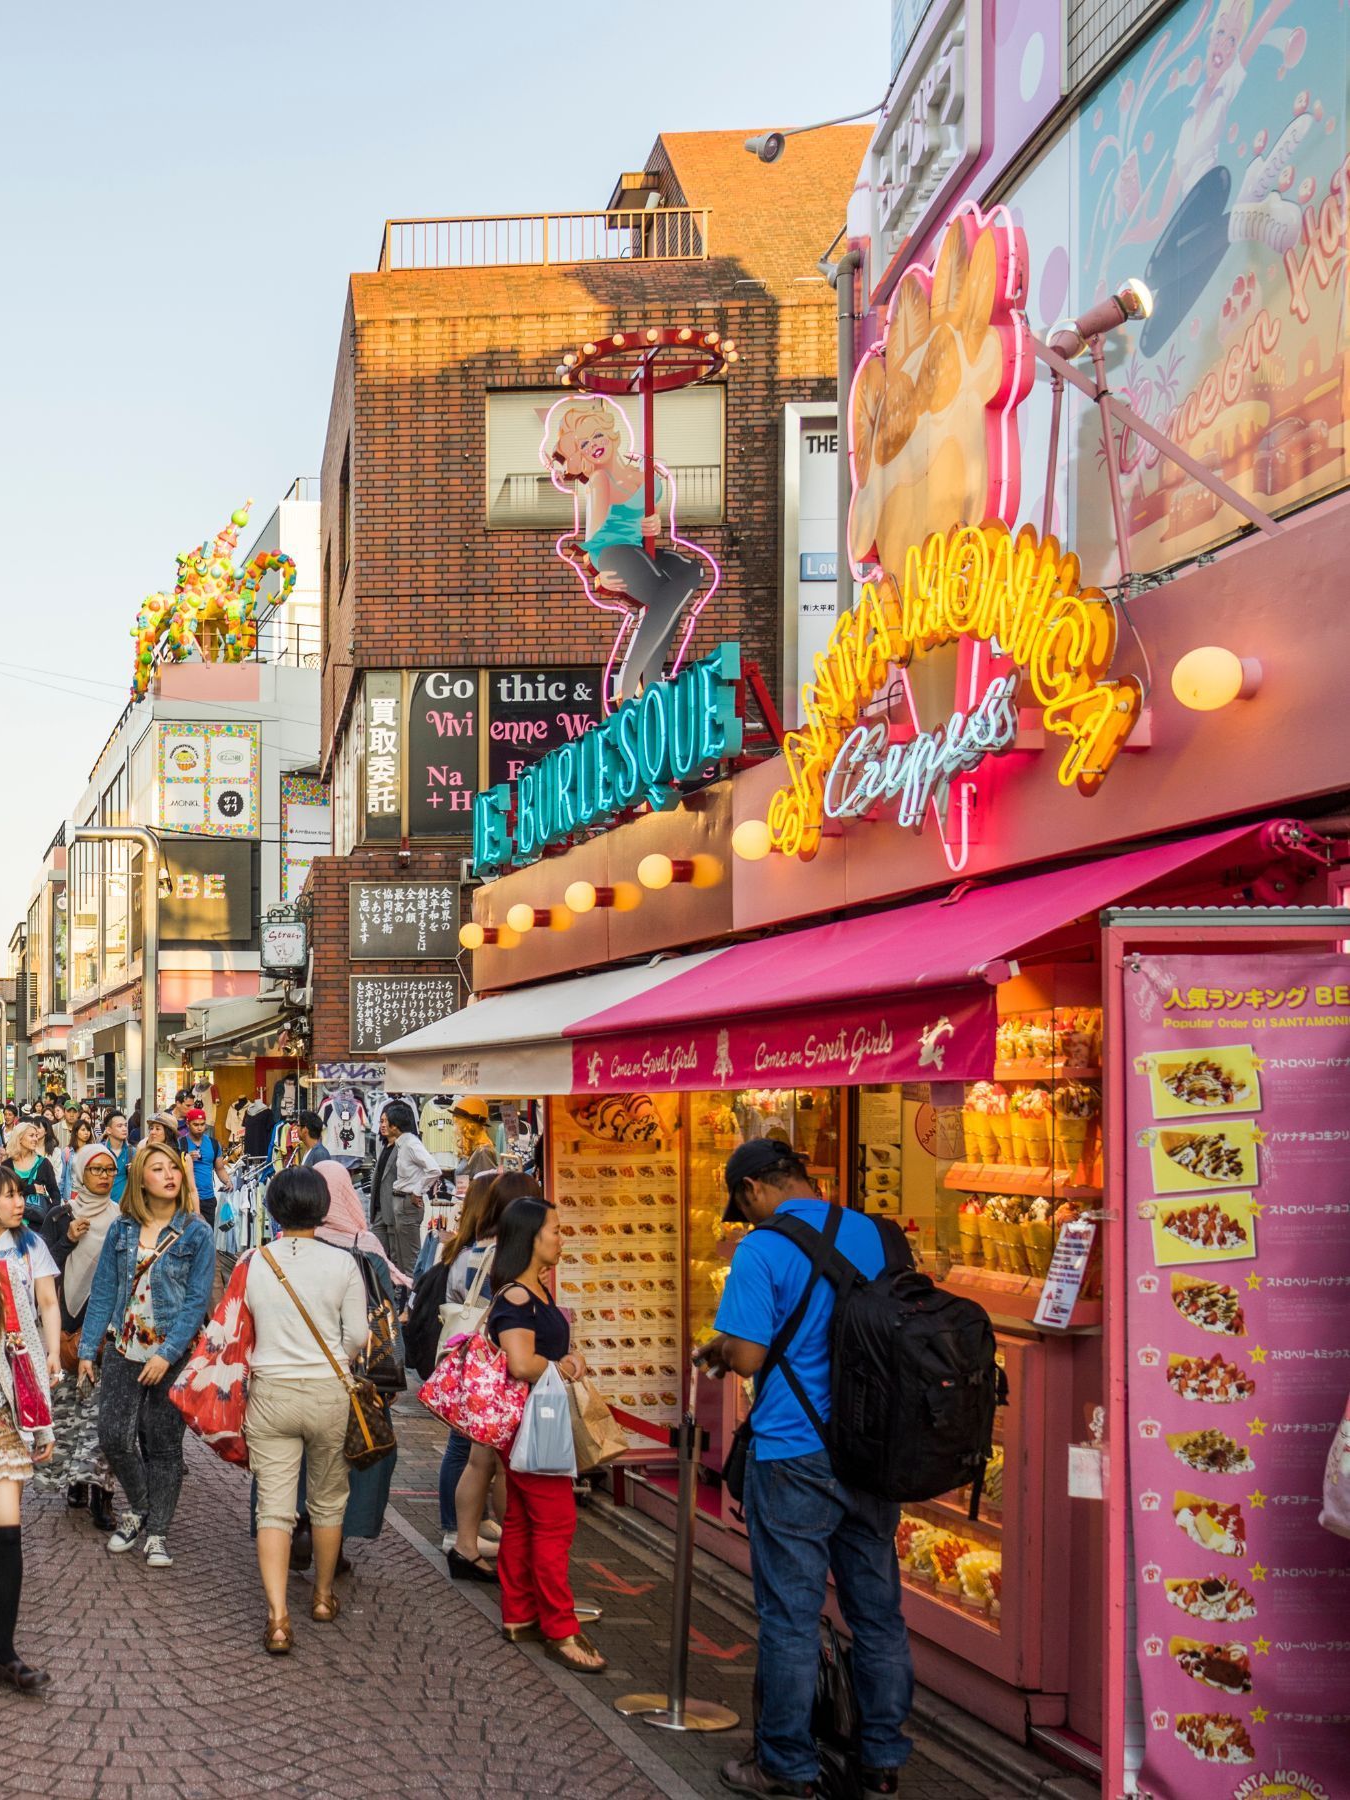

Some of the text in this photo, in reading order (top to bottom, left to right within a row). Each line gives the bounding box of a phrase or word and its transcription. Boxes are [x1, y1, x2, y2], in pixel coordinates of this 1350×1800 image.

[805, 434, 837, 454] THE
[367, 698, 397, 813] 買取委託
[515, 652, 743, 858] BURLESQUE
[358, 888, 370, 945] と思います
[371, 888, 381, 924] である
[394, 888, 405, 923] 最高の
[405, 887, 417, 924] 全人類
[417, 888, 429, 951] 創造することは
[429, 887, 440, 932] 大平和を
[440, 887, 453, 930] 全世界の
[365, 981, 373, 1033] 大平和創造の
[383, 982, 391, 1026] しあわせを
[392, 982, 400, 1020] わけあう
[400, 982, 408, 1035] はげましあう
[409, 982, 417, 1028] たすけあう
[1163, 986, 1309, 1010] 人気ランキング
[1162, 1017, 1214, 1030] Popular
[1217, 1017, 1248, 1029] Order
[610, 1056, 634, 1079] Come
[641, 1046, 670, 1078] Sweet
[670, 1040, 698, 1084] Girls
[754, 1020, 894, 1075] Come on Sweet Girls
